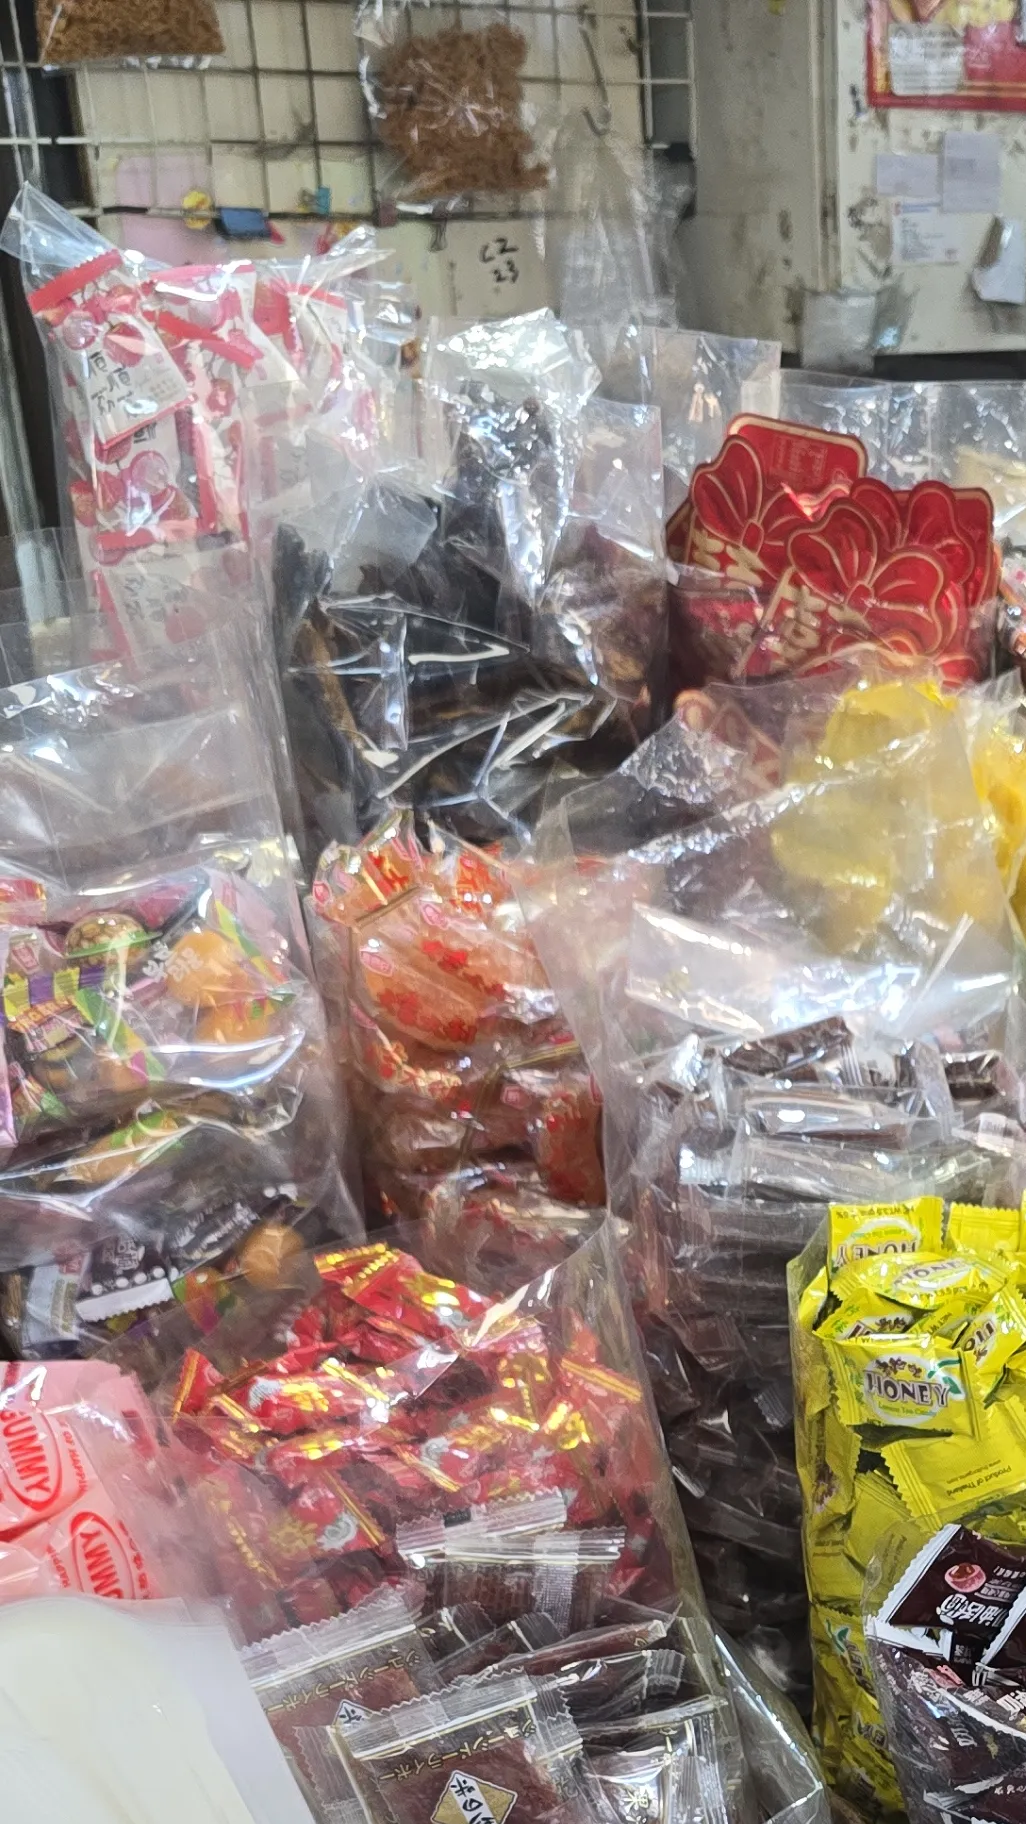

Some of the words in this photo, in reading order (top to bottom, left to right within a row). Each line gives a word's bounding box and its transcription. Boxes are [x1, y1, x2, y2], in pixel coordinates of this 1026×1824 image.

[865, 1371, 949, 1408] HONEY
[0, 1410, 51, 1493] GUMMY
[79, 1530, 125, 1600] UMMY
